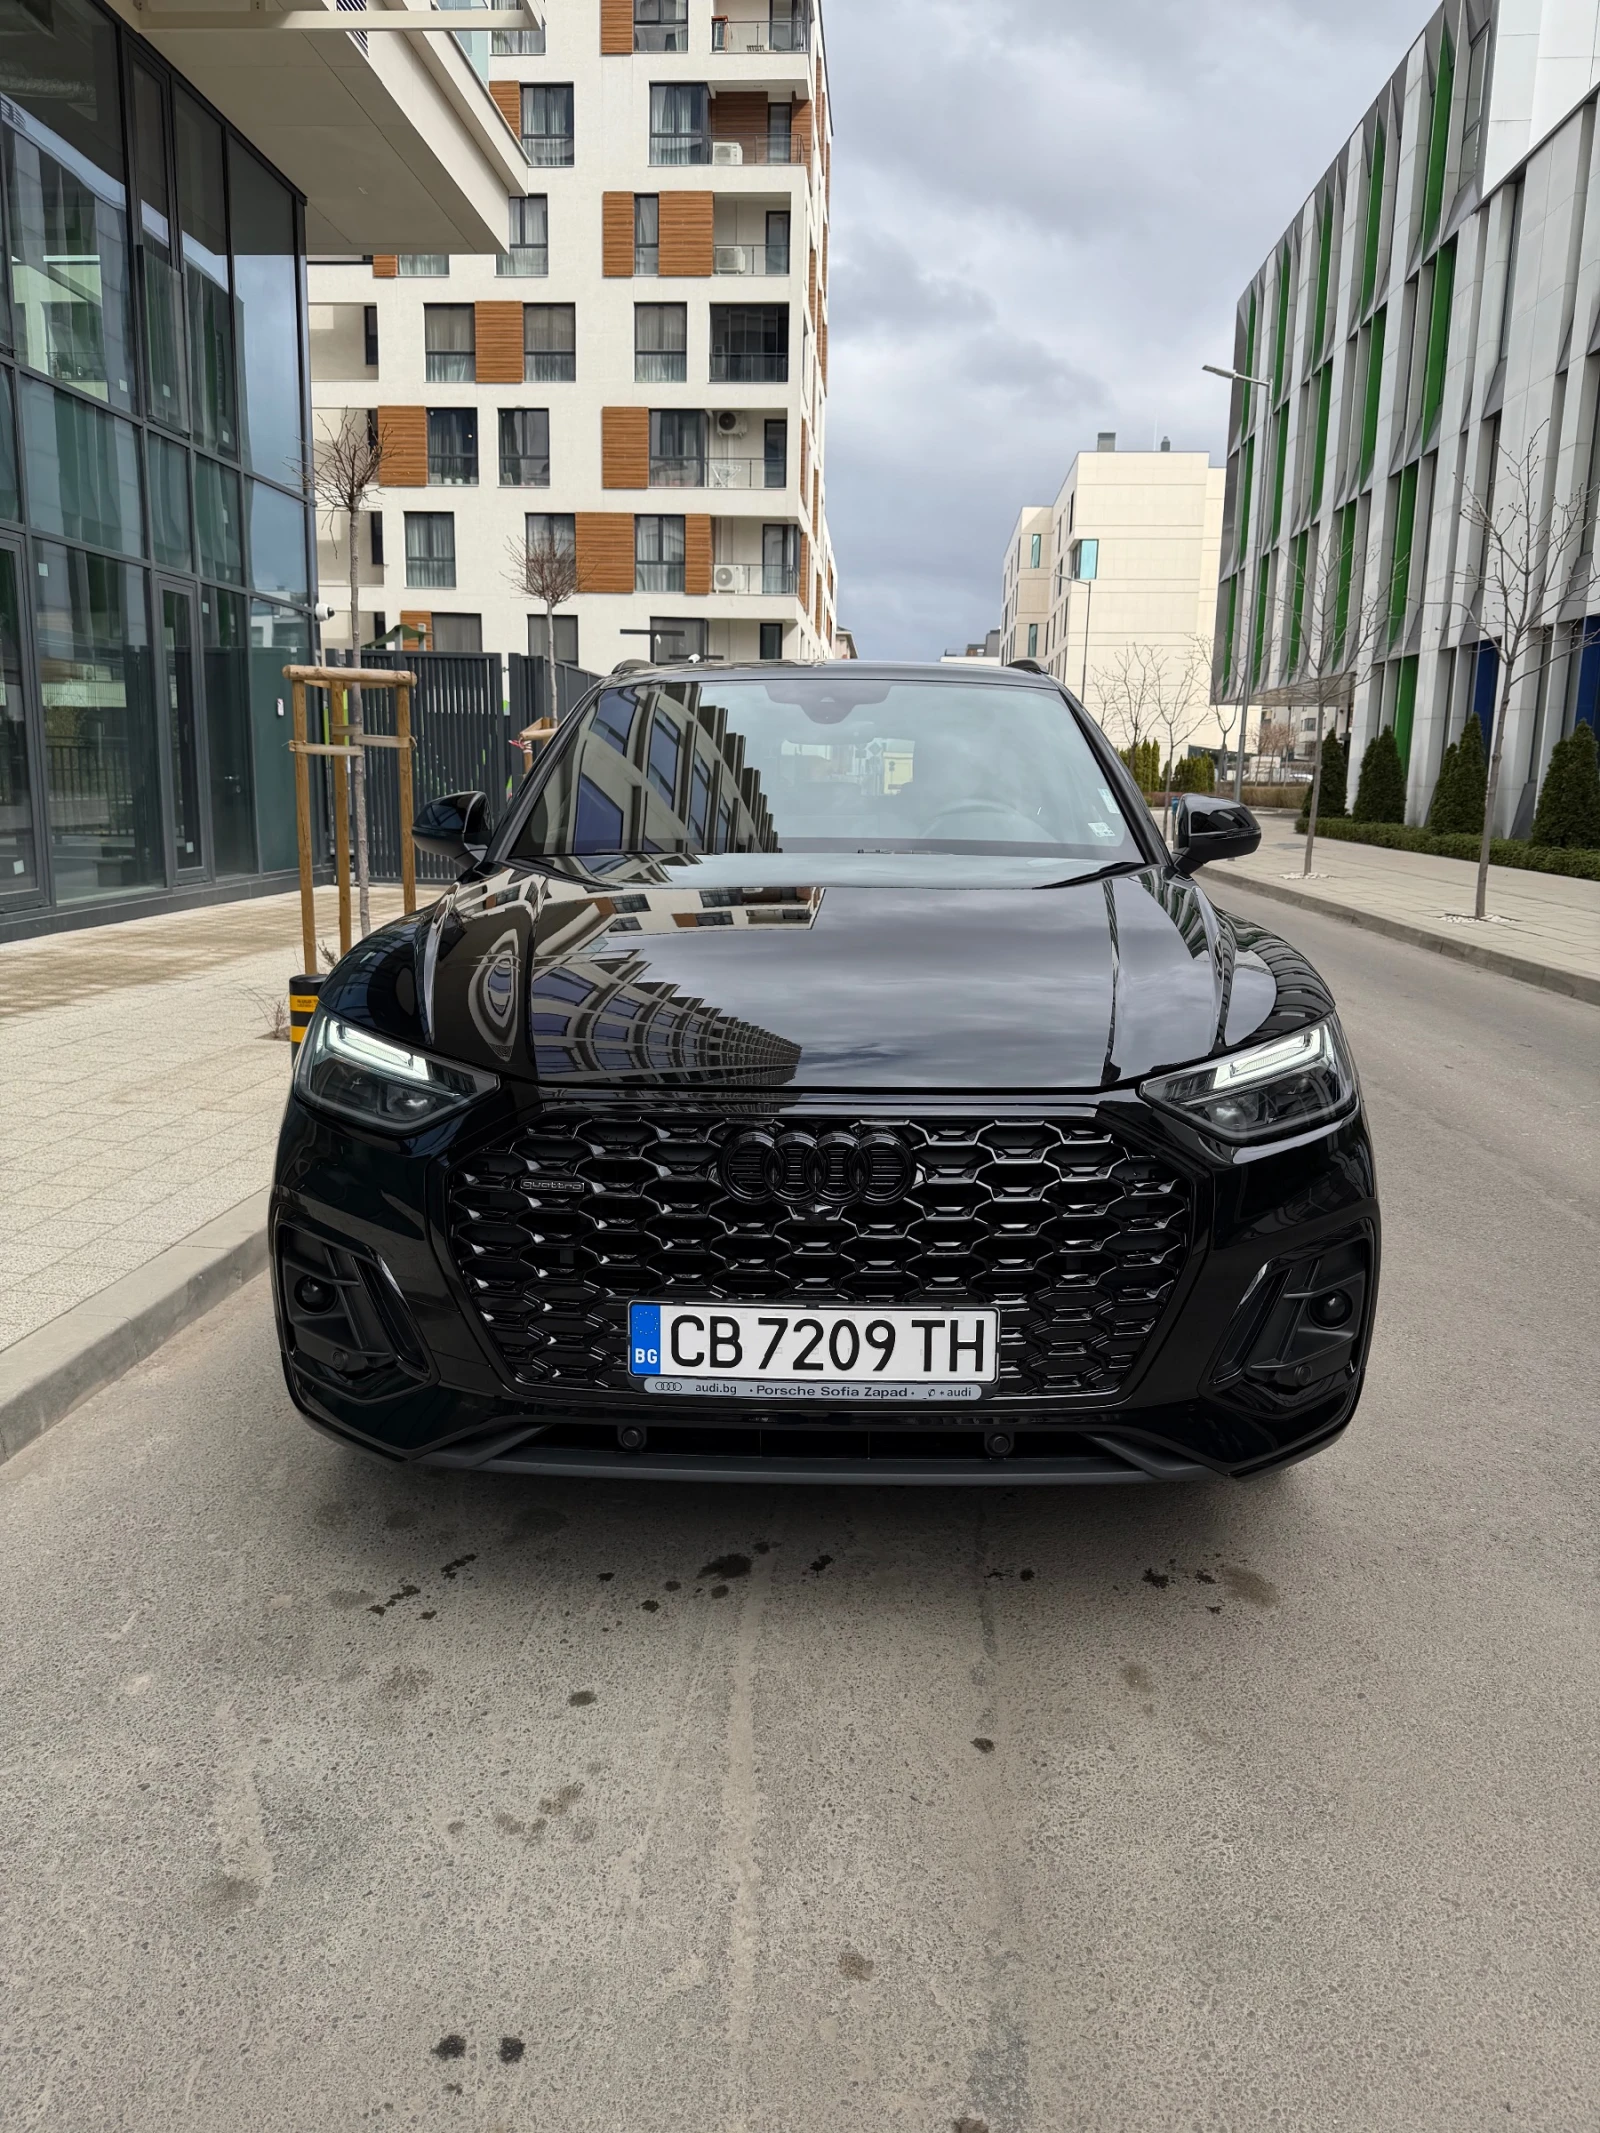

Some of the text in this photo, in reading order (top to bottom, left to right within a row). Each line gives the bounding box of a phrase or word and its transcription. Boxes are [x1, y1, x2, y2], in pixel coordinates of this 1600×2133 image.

[522, 1181, 582, 1190] quattro
[671, 1314, 984, 1372] CB 7209 TH
[635, 1348, 658, 1364] BG
[695, 1383, 737, 1395] audi.bg
[756, 1385, 908, 1399] Porsche Sofia Zapad
